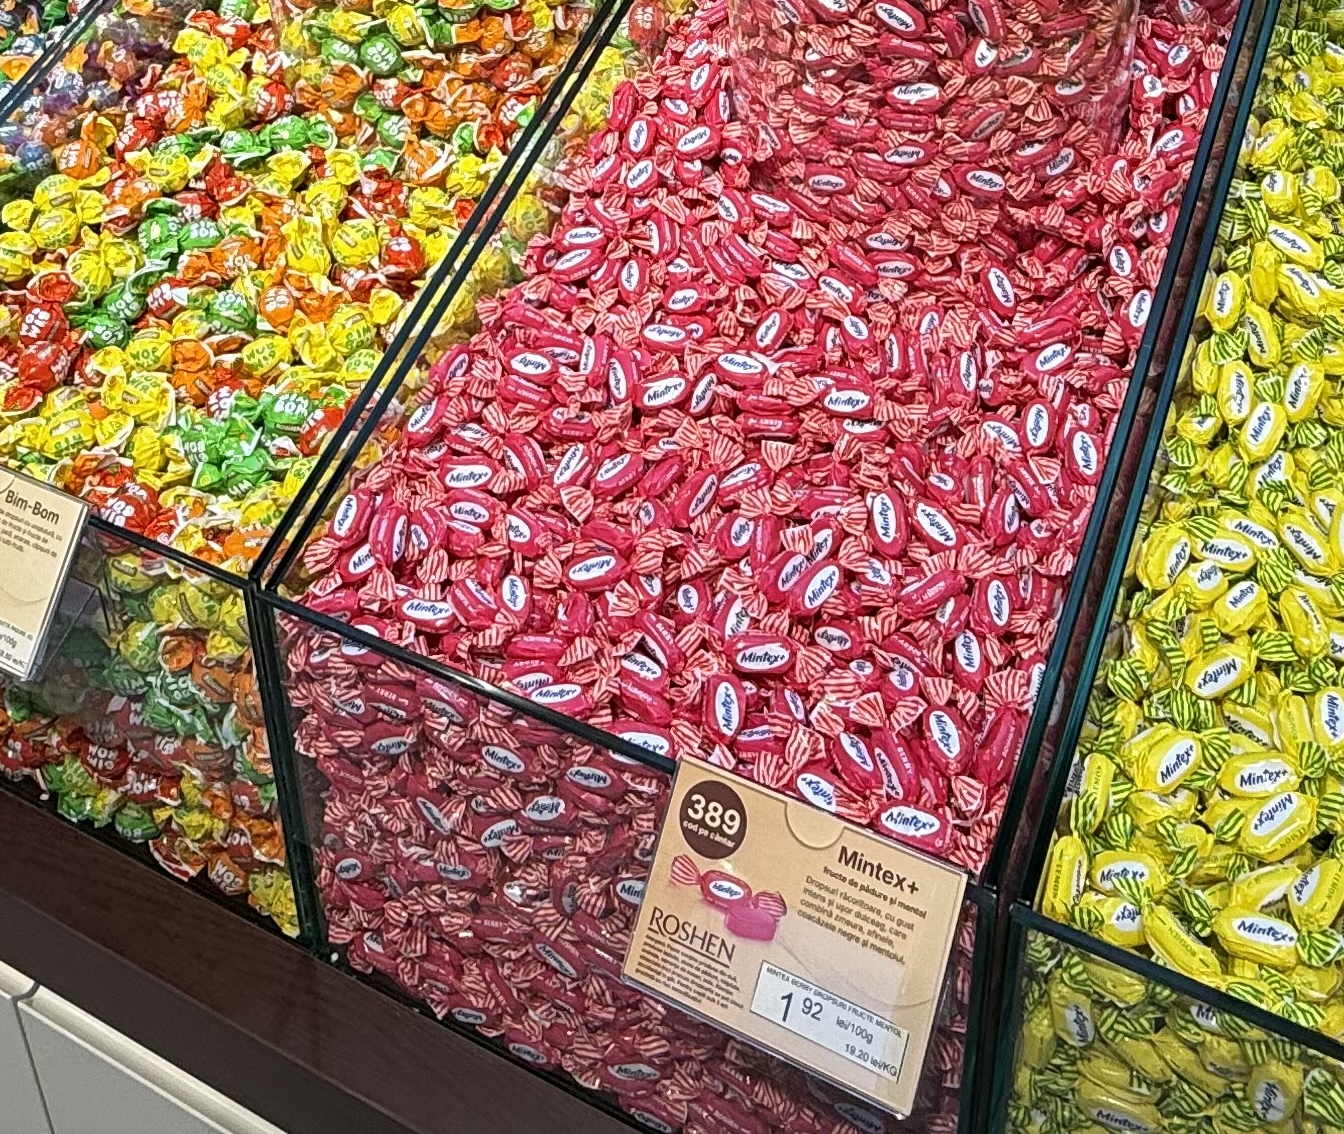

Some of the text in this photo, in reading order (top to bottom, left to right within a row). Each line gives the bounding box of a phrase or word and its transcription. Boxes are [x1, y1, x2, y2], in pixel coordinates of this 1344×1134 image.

[721, 355, 759, 370] Mintex+
[1040, 348, 1069, 367] Mintex+
[648, 379, 683, 401] Mintex+
[828, 396, 865, 407] Mintex+
[1250, 408, 1271, 441] Mintex+
[449, 468, 488, 483] Mintex+
[5, 489, 60, 525] Bim-Bom
[882, 496, 892, 536] Mintex+
[921, 505, 953, 542] Mintex+
[1235, 522, 1277, 547] Mintex+
[1288, 526, 1322, 560] Mintex+
[1167, 542, 1187, 582] Mintex+
[1201, 544, 1247, 559] Mintex+
[808, 571, 837, 606] Mintex+
[407, 602, 449, 615] Mintex+
[741, 651, 785, 665] Mintex+
[1197, 658, 1238, 691] Mintex+
[535, 688, 577, 699] Mintex+
[725, 686, 733, 730] Mintex+
[1327, 695, 1339, 738] Mintex+
[934, 715, 954, 754] Mintex+
[485, 748, 521, 769] Mintex+
[1161, 745, 1195, 782] Mintex+
[1240, 769, 1288, 787] Mintex+
[687, 794, 741, 835] 389
[885, 811, 935, 830] Mintex+
[1254, 794, 1293, 829] Mintex+
[683, 820, 698, 832] cod
[698, 827, 709, 837] pe
[838, 845, 919, 894] Mintex+
[806, 875, 838, 895] Dropsuri
[885, 912, 896, 922] cu
[896, 916, 915, 931] gust
[823, 866, 847, 883] fructe
[848, 878, 859, 888] de
[897, 901, 927, 919] mentol
[649, 906, 736, 963] ROSHEN
[838, 927, 860, 944] negre
[889, 926, 907, 940] care
[1238, 920, 1294, 943] Mintex+
[781, 992, 873, 1044] 1 92 lei/100g
[848, 1005, 874, 1023] FRUCTE
[876, 1019, 902, 1038] MENTOL
[845, 1043, 869, 1063] 19.20
